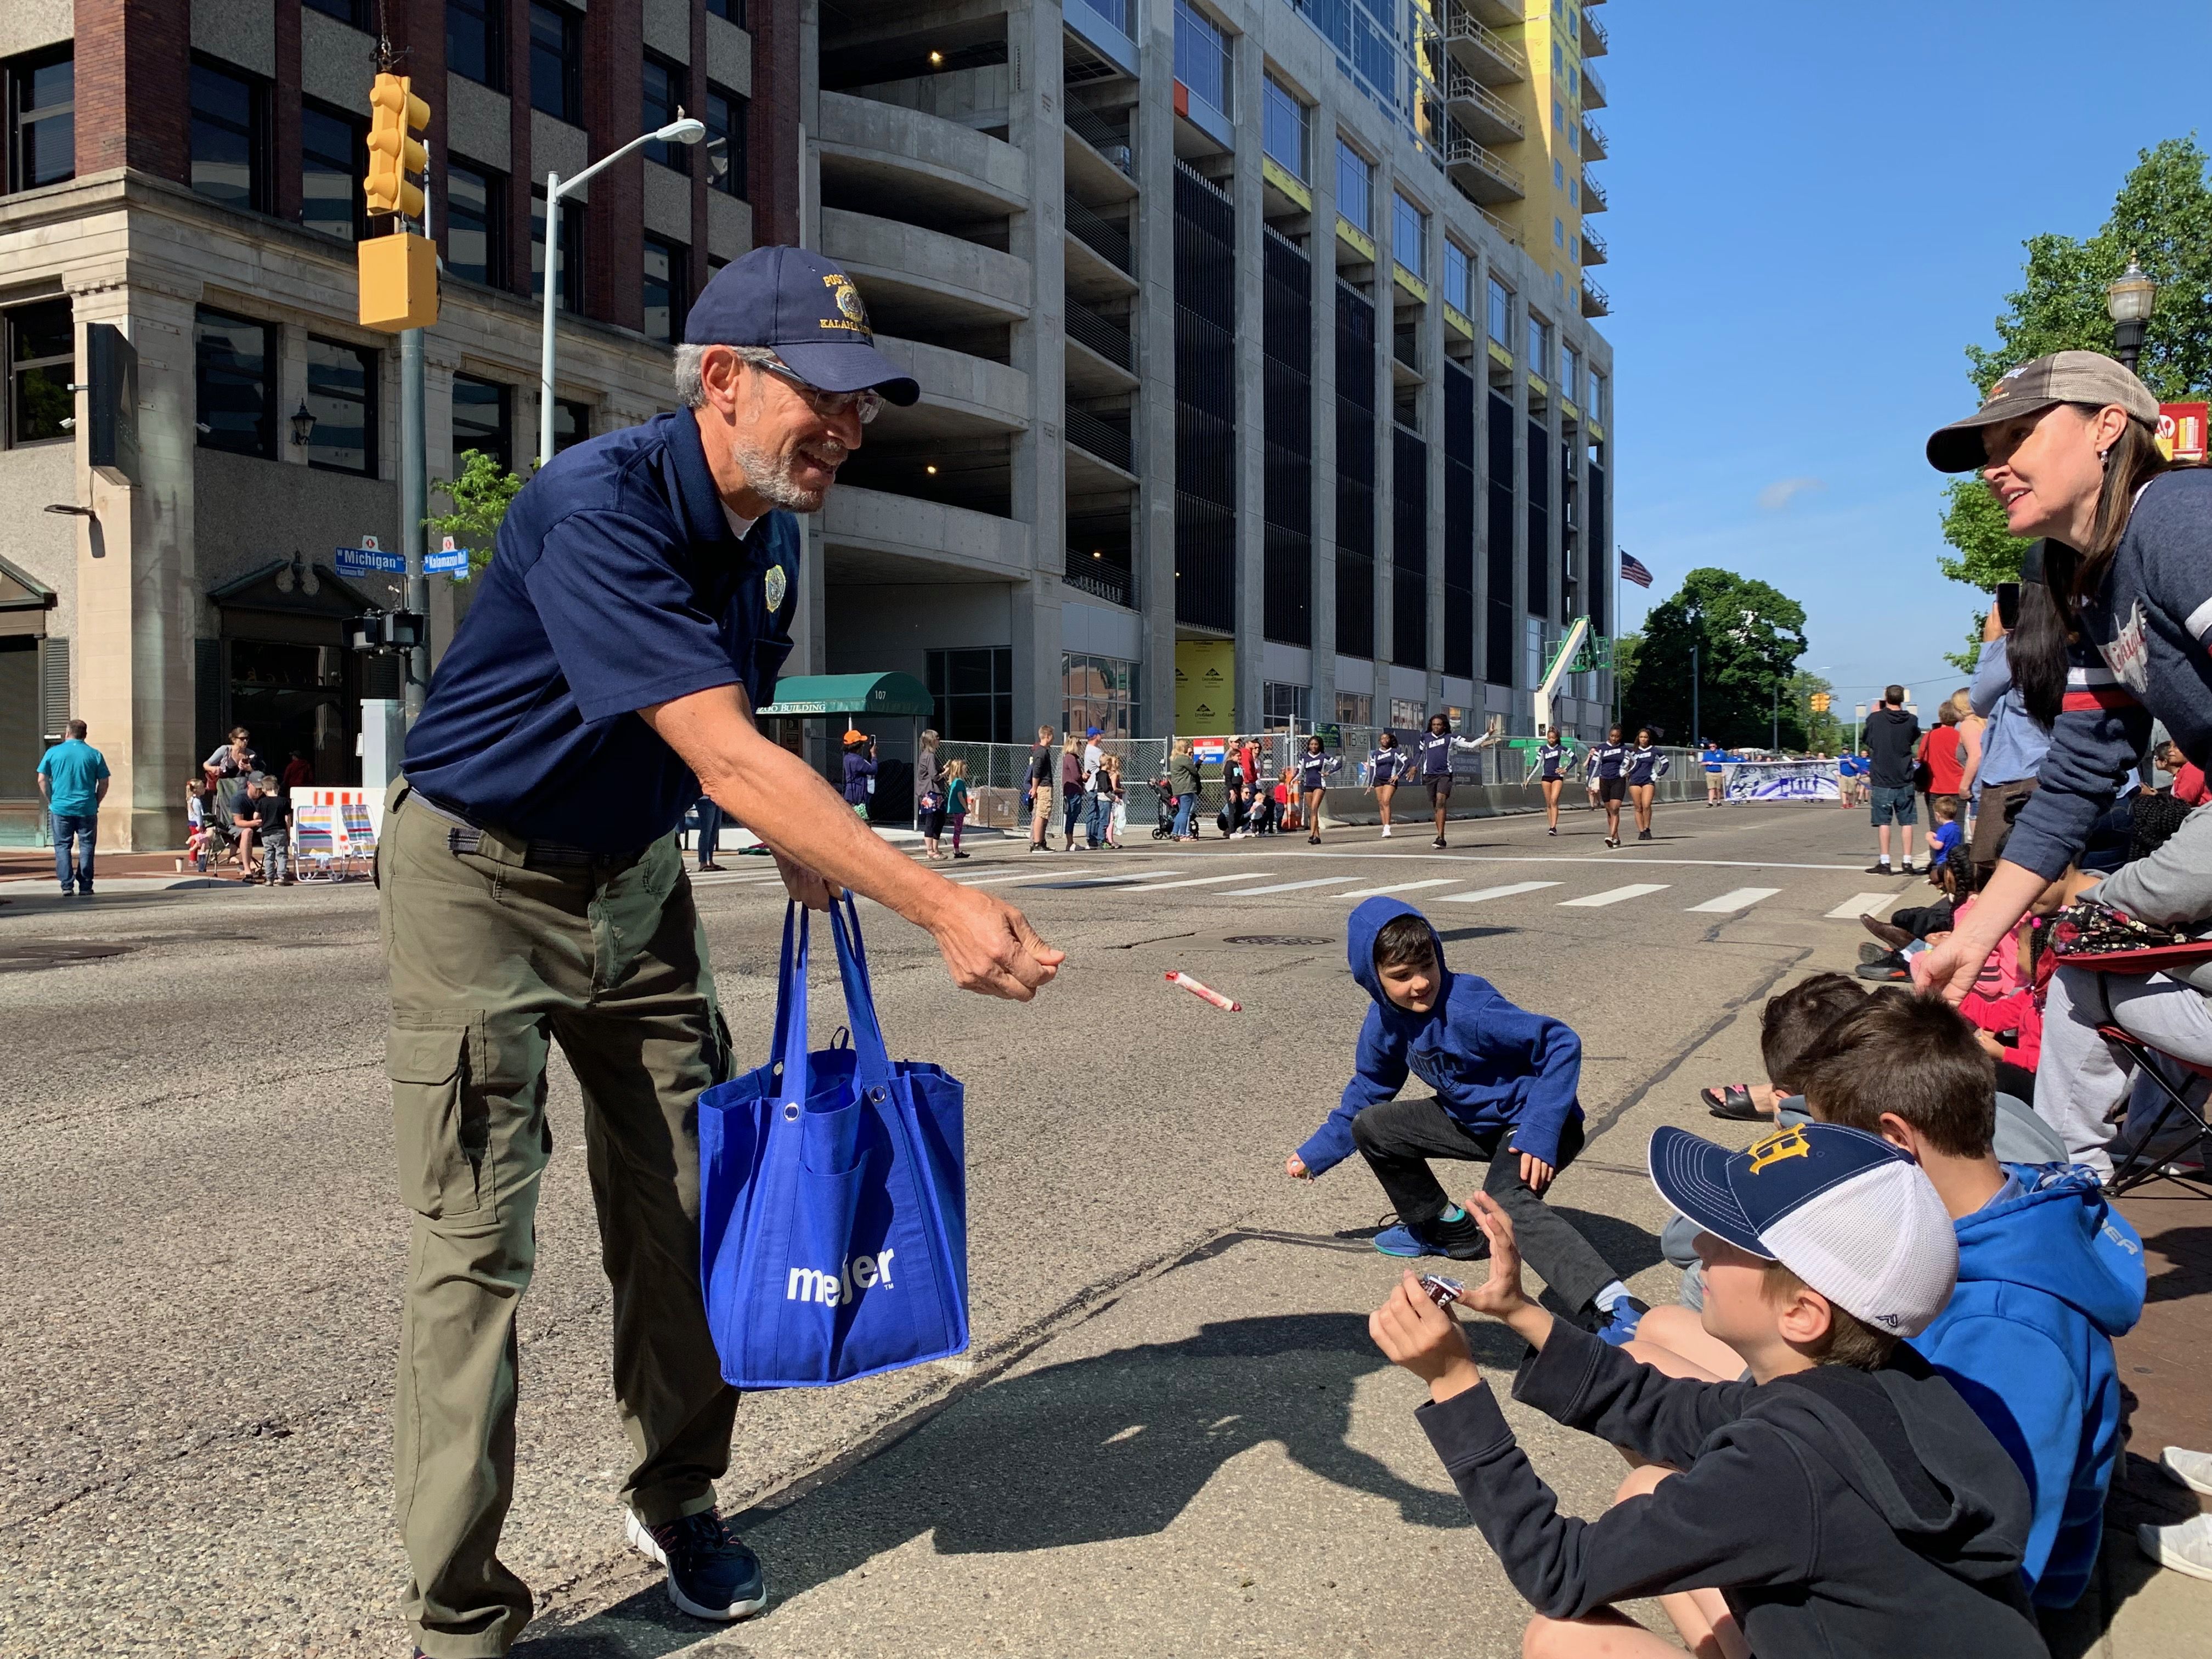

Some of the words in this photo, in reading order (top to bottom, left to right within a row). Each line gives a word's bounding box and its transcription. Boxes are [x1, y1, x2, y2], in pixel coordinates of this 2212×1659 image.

[344, 550, 396, 569] Michigan
[424, 556, 428, 564] S
[429, 555, 458, 569] Kalamazoo
[874, 690, 887, 700] 107
[781, 703, 826, 712] BUILDING
